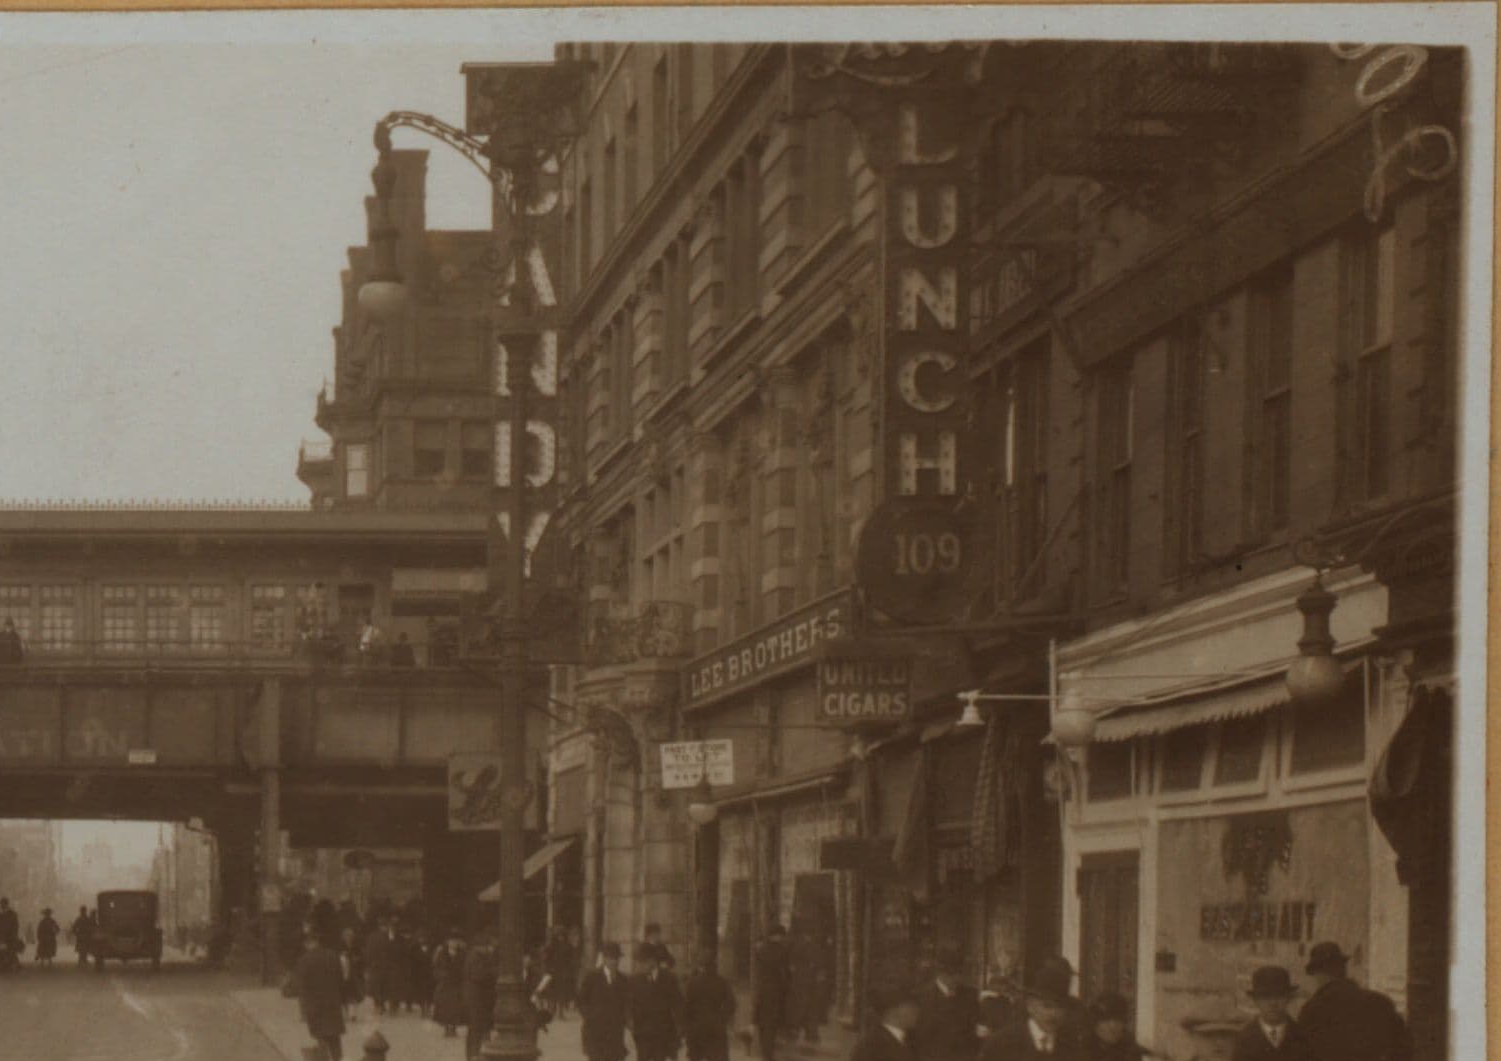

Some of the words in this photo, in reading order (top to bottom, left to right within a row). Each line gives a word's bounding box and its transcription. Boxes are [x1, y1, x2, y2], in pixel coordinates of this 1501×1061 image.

[901, 109, 958, 496] LUNCH
[895, 533, 961, 575] 109
[691, 661, 724, 698] LEE
[728, 608, 840, 680] BROTHERS
[824, 659, 907, 686] UNITED
[823, 691, 907, 717] CIGARS
